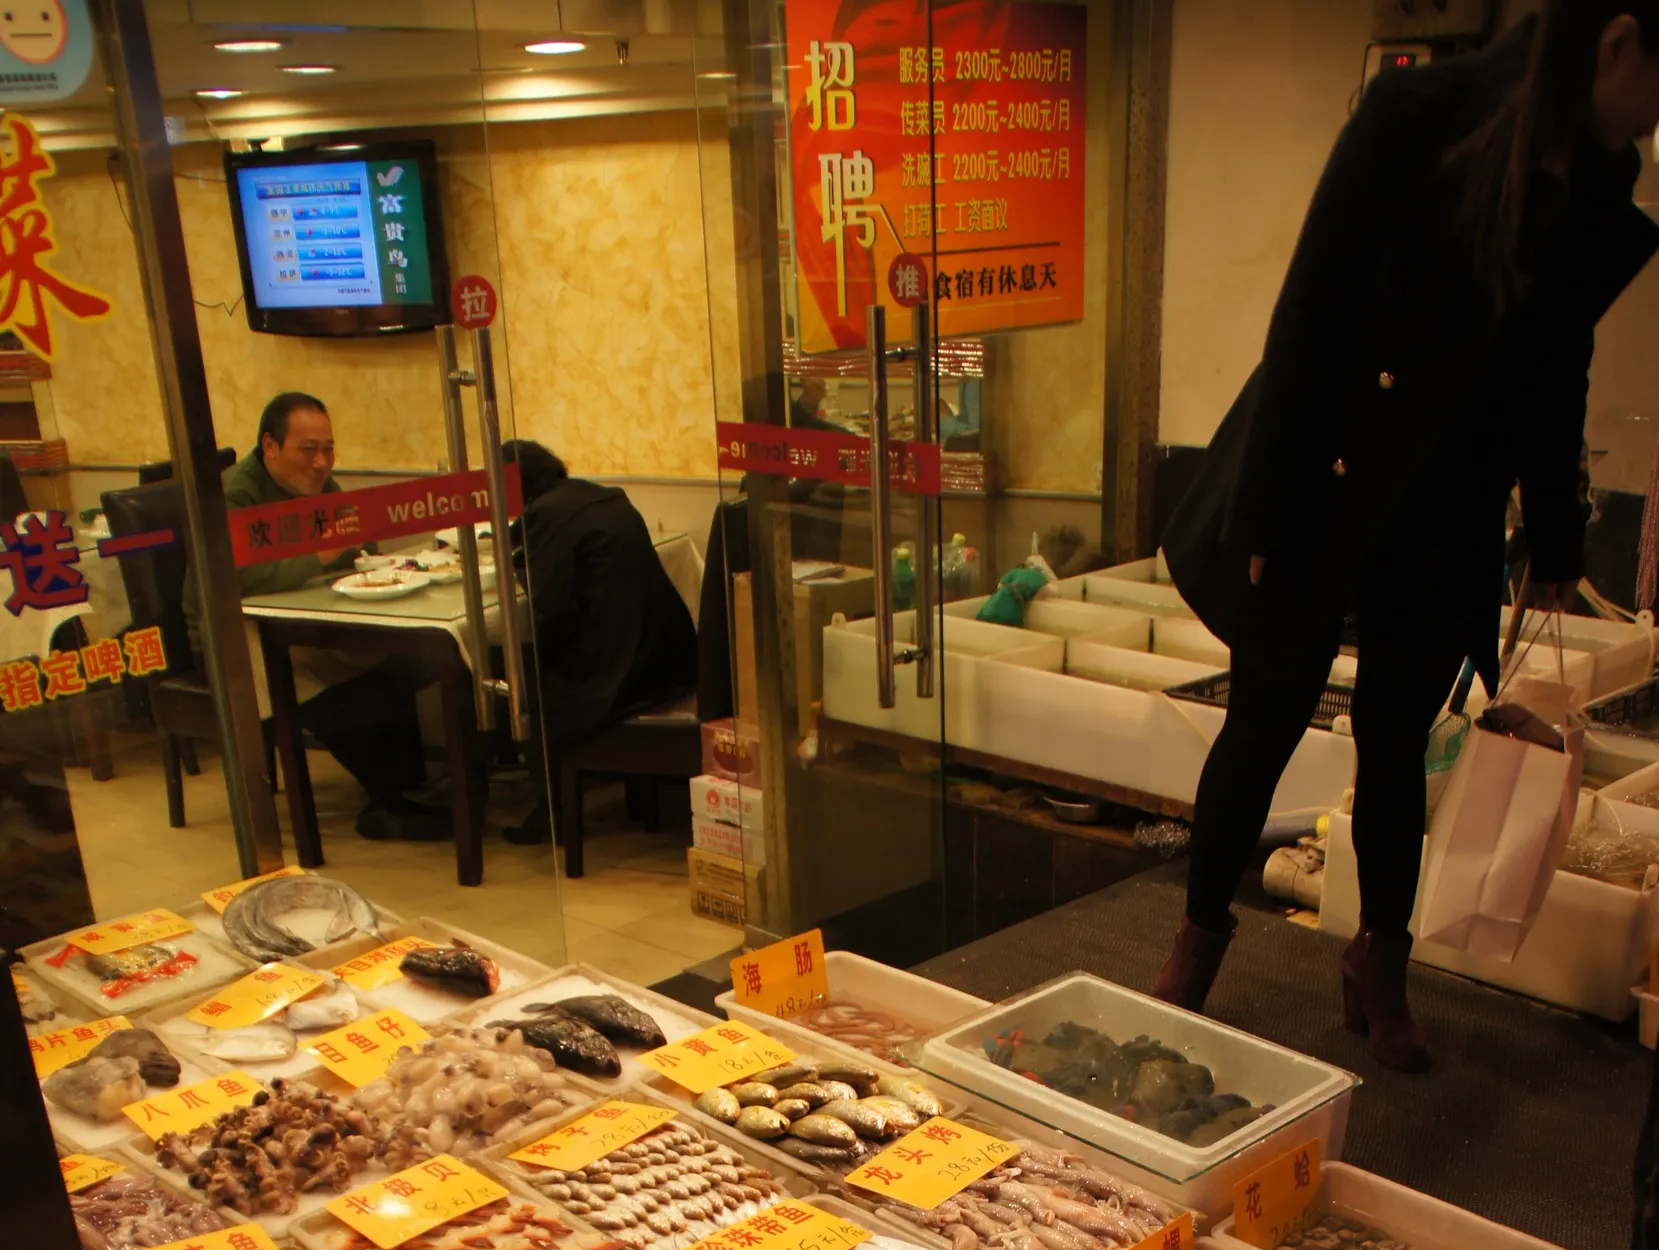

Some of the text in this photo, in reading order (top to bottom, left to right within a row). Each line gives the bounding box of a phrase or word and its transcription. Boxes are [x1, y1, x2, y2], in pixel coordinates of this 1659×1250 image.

[899, 46, 945, 83] 服务员
[901, 100, 946, 137] 传菜员
[804, 39, 884, 318] 招聘
[902, 152, 946, 187] 洗碗工
[904, 198, 1008, 239] 打荷工 工资面议
[896, 263, 919, 298] 推
[924, 261, 1057, 300] 食宿有休息天
[460, 285, 490, 322] 拉
[386, 488, 491, 525] welcom
[0, 625, 167, 713] 指定啤酒
[742, 941, 813, 997] 海肠
[312, 1016, 406, 1064] 目鱼仔
[654, 1027, 751, 1069] 小黄鱼
[142, 1078, 249, 1122] 八爪鱼
[344, 1161, 460, 1215] 北极贝
[1244, 1150, 1311, 1223] 花蛤
